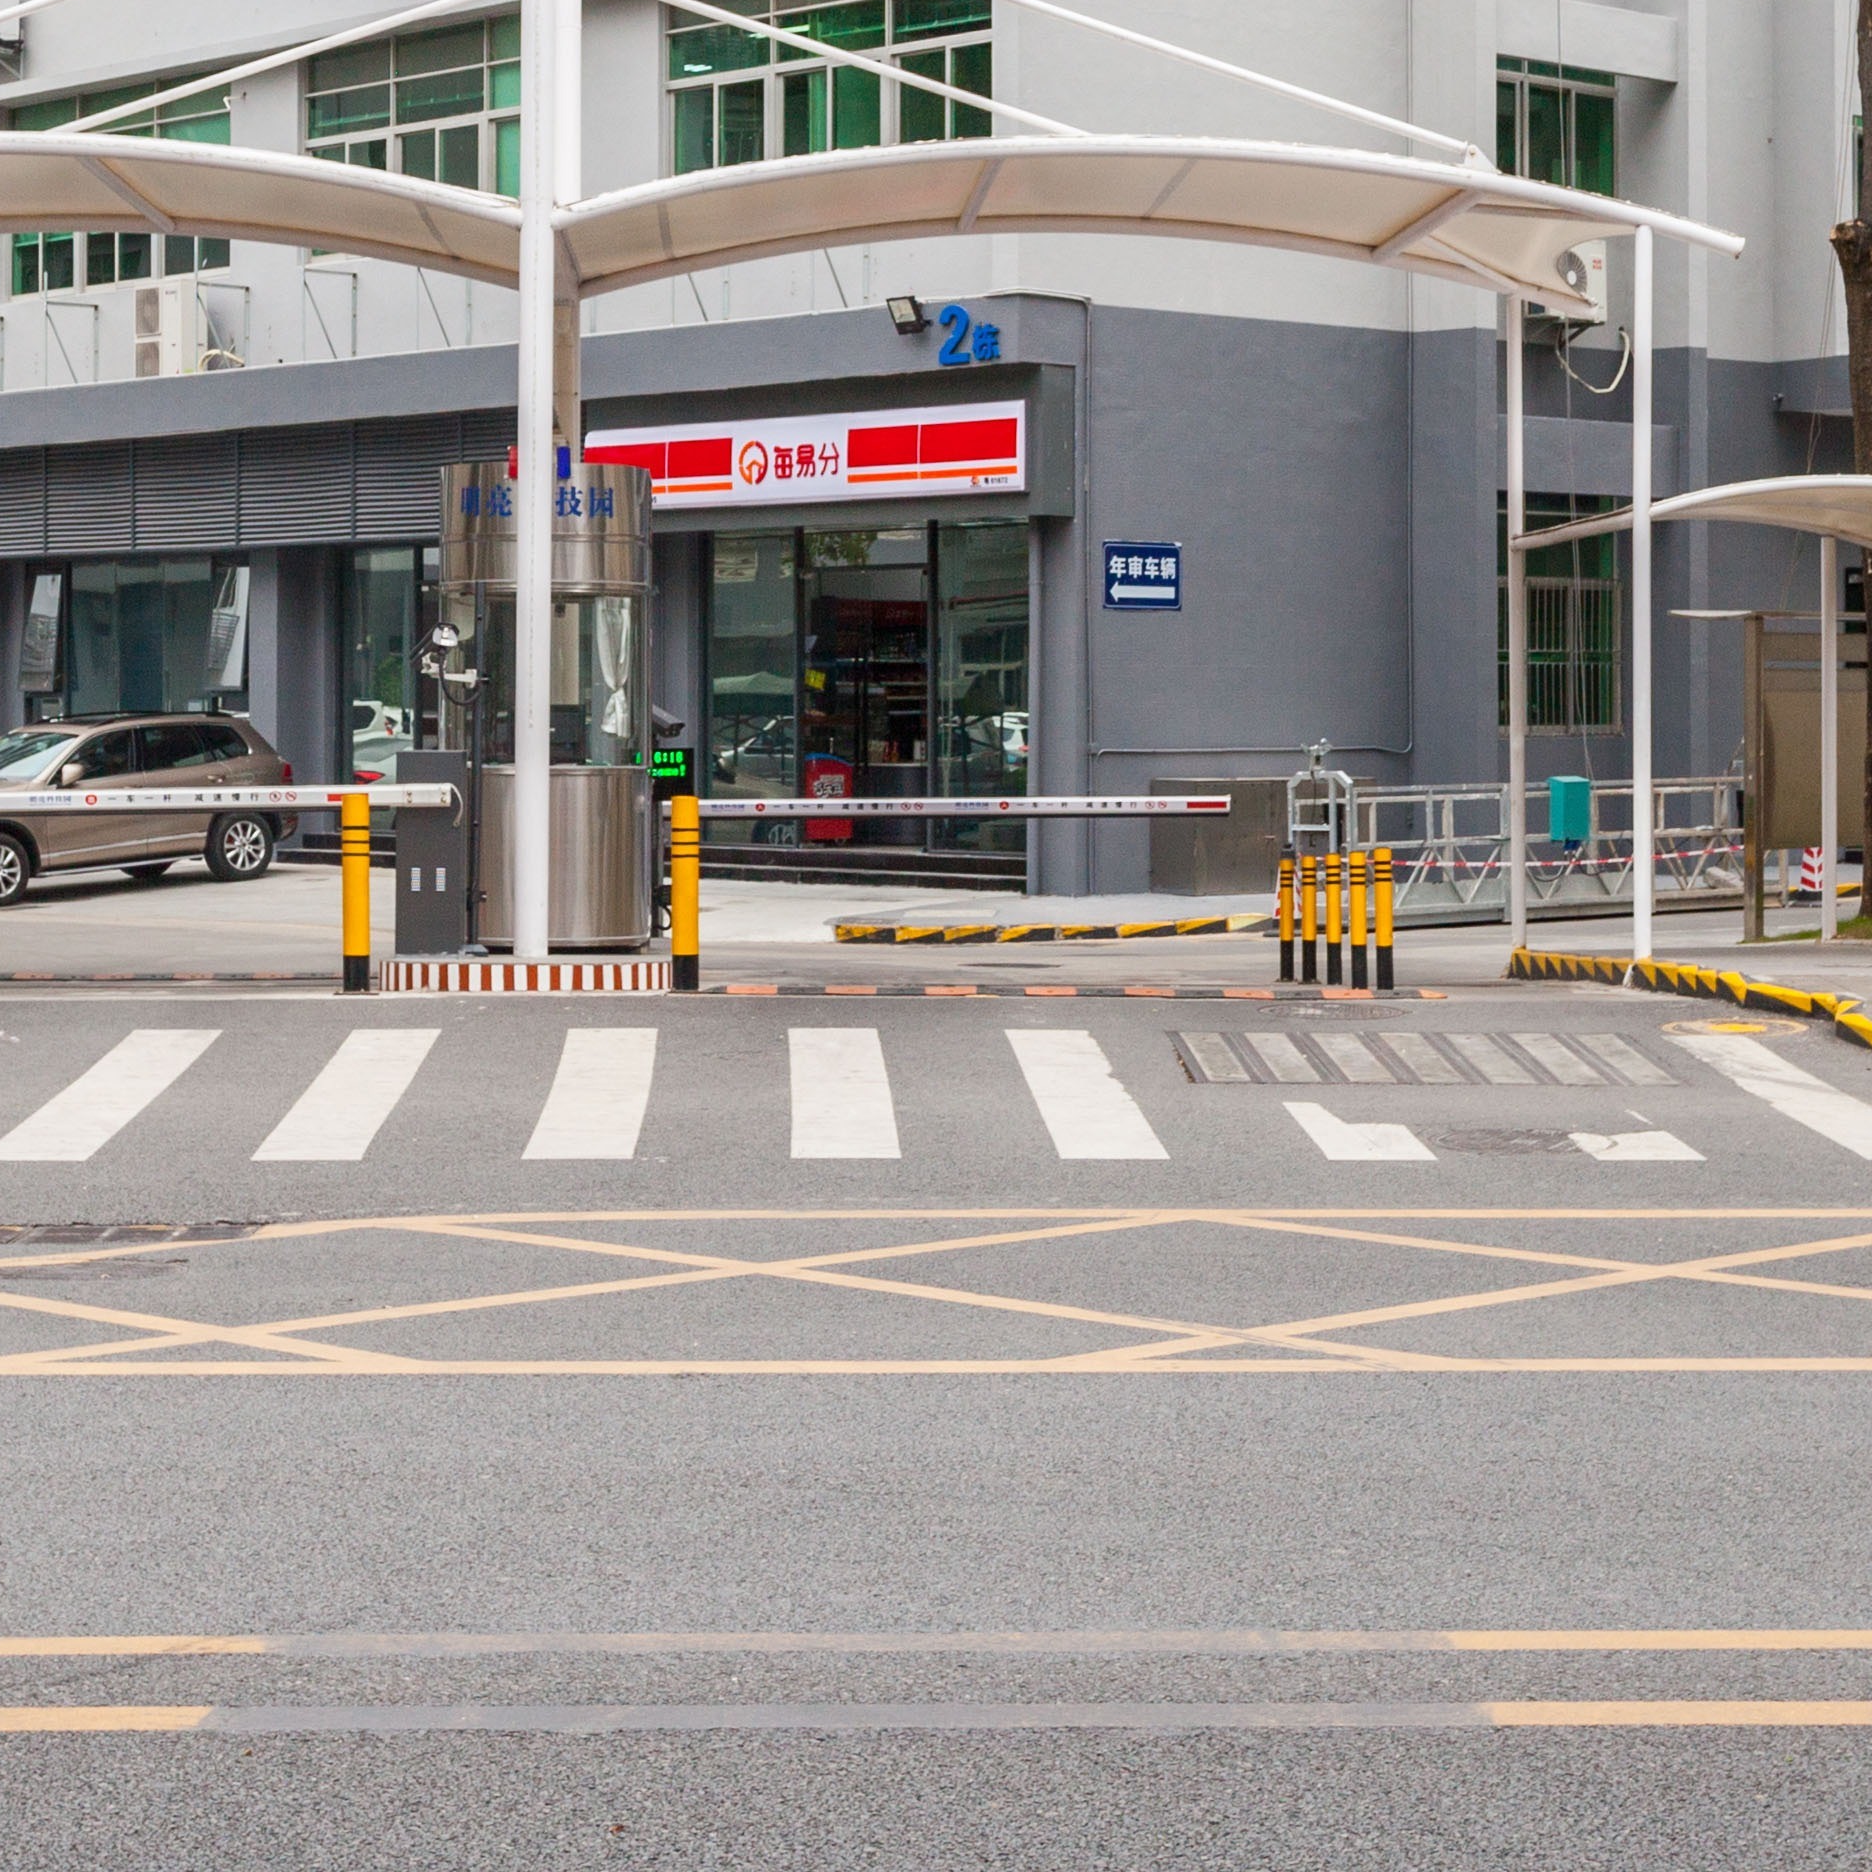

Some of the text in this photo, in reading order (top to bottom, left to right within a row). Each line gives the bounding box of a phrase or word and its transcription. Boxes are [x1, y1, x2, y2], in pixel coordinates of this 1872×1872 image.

[461, 485, 615, 519] 明亮技园
[1109, 555, 1177, 580] 年审车辆
